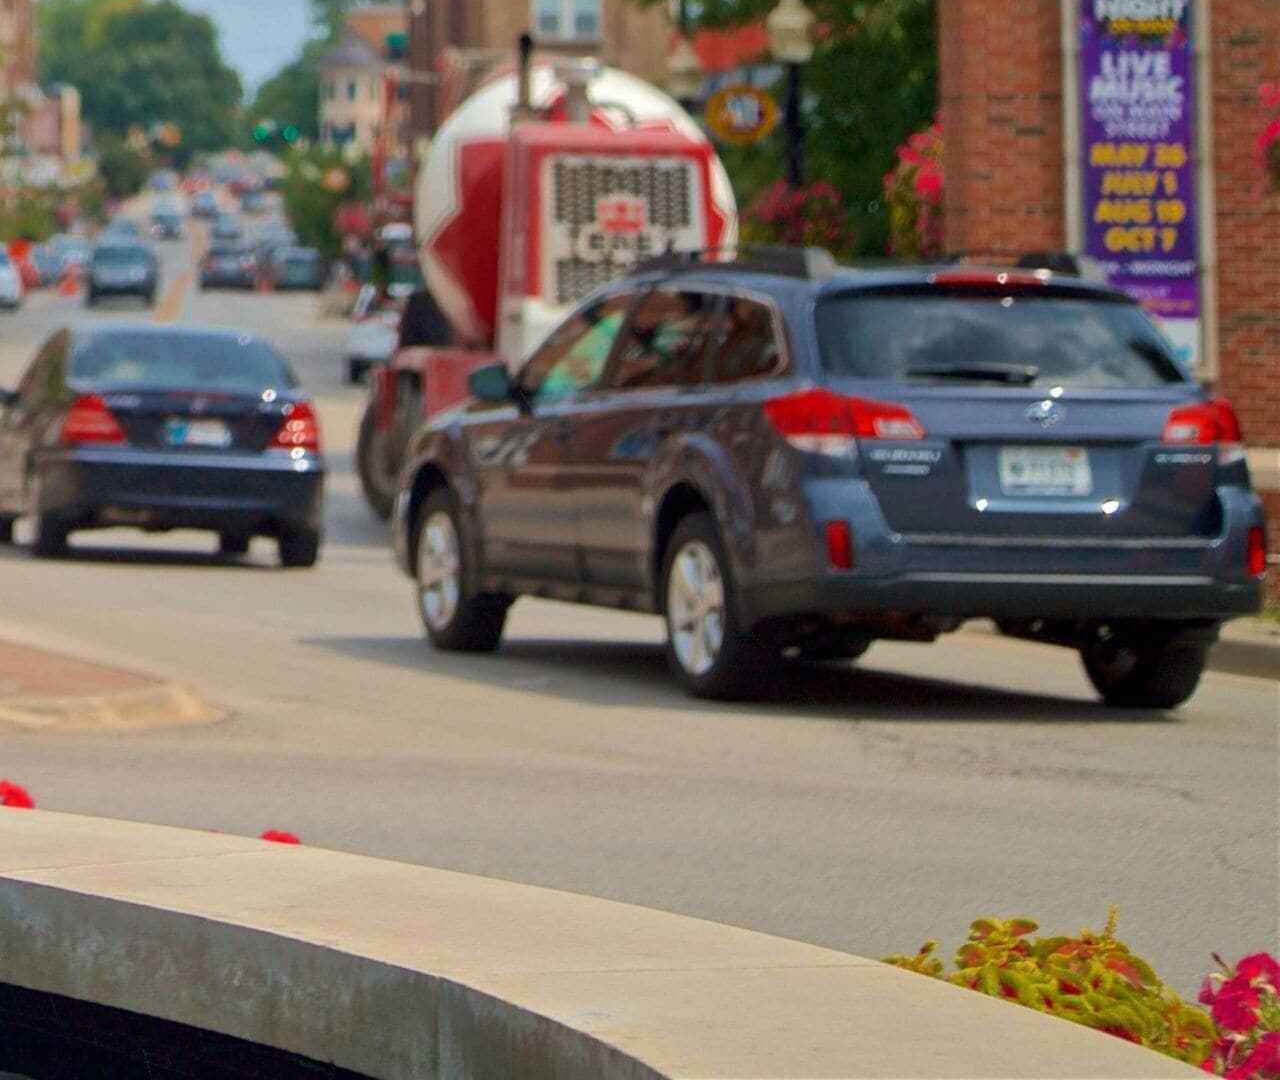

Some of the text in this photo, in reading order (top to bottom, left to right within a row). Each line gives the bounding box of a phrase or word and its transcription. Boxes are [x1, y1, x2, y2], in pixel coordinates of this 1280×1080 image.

[1101, 50, 1171, 78] LIVE
[1090, 75, 1184, 103] MUSIC
[1091, 142, 1150, 168] MAY
[1094, 198, 1152, 224] AUG
[1104, 225, 1156, 252] OCT
